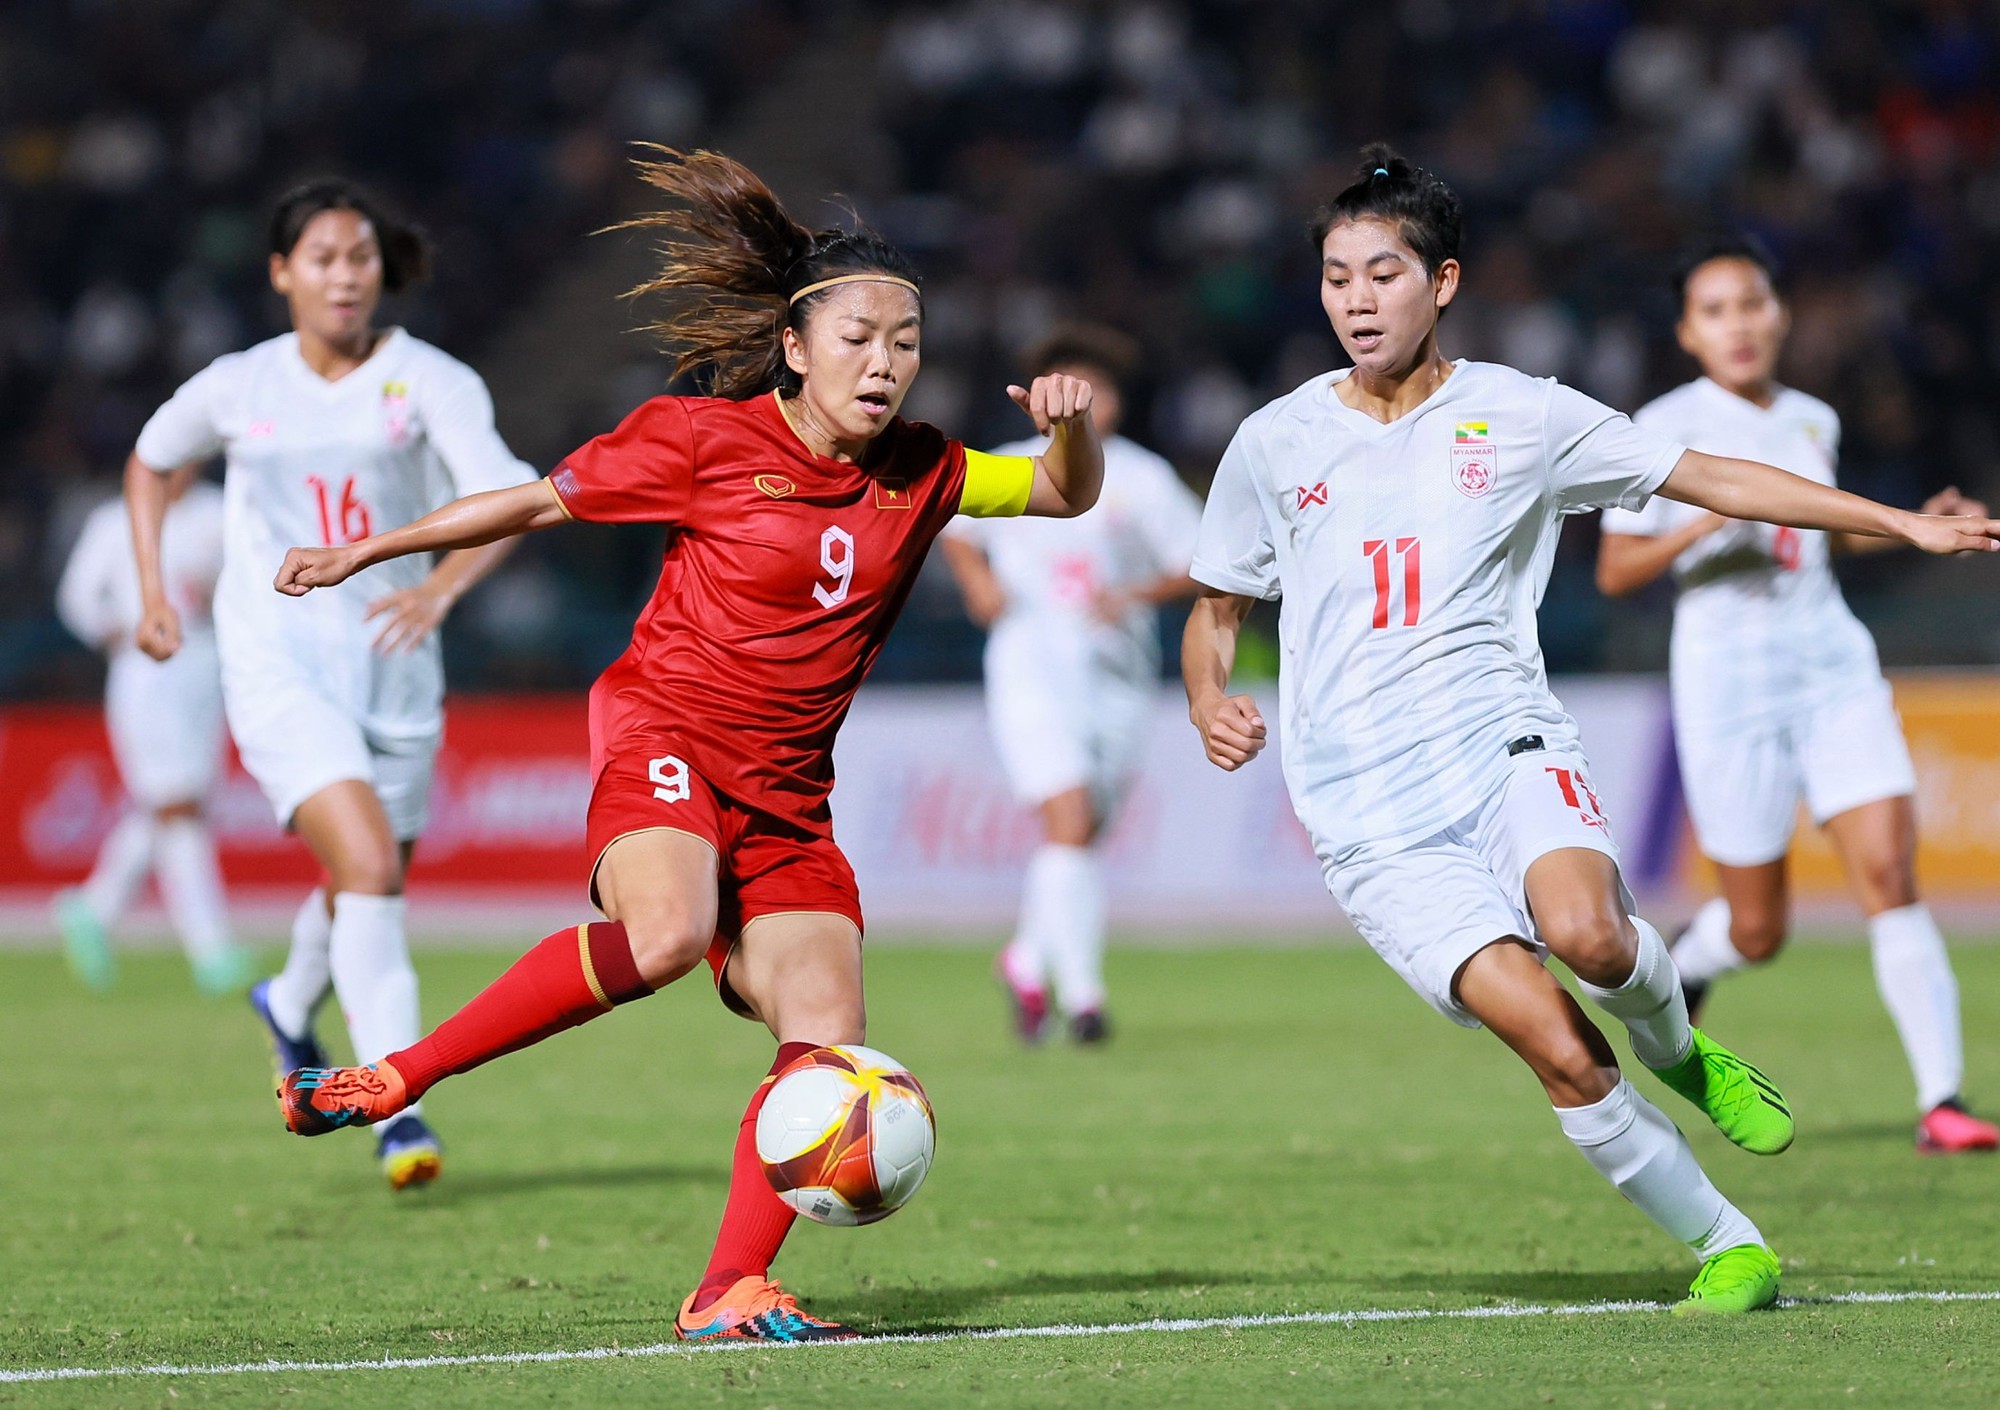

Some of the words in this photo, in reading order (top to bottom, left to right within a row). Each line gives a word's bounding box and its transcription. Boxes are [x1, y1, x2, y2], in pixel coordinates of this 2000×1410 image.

[1453, 448, 1493, 456] MYANMAR
[306, 475, 371, 545] 16
[811, 524, 855, 609] 9
[1363, 536, 1421, 628] 11
[648, 754, 691, 804] 9
